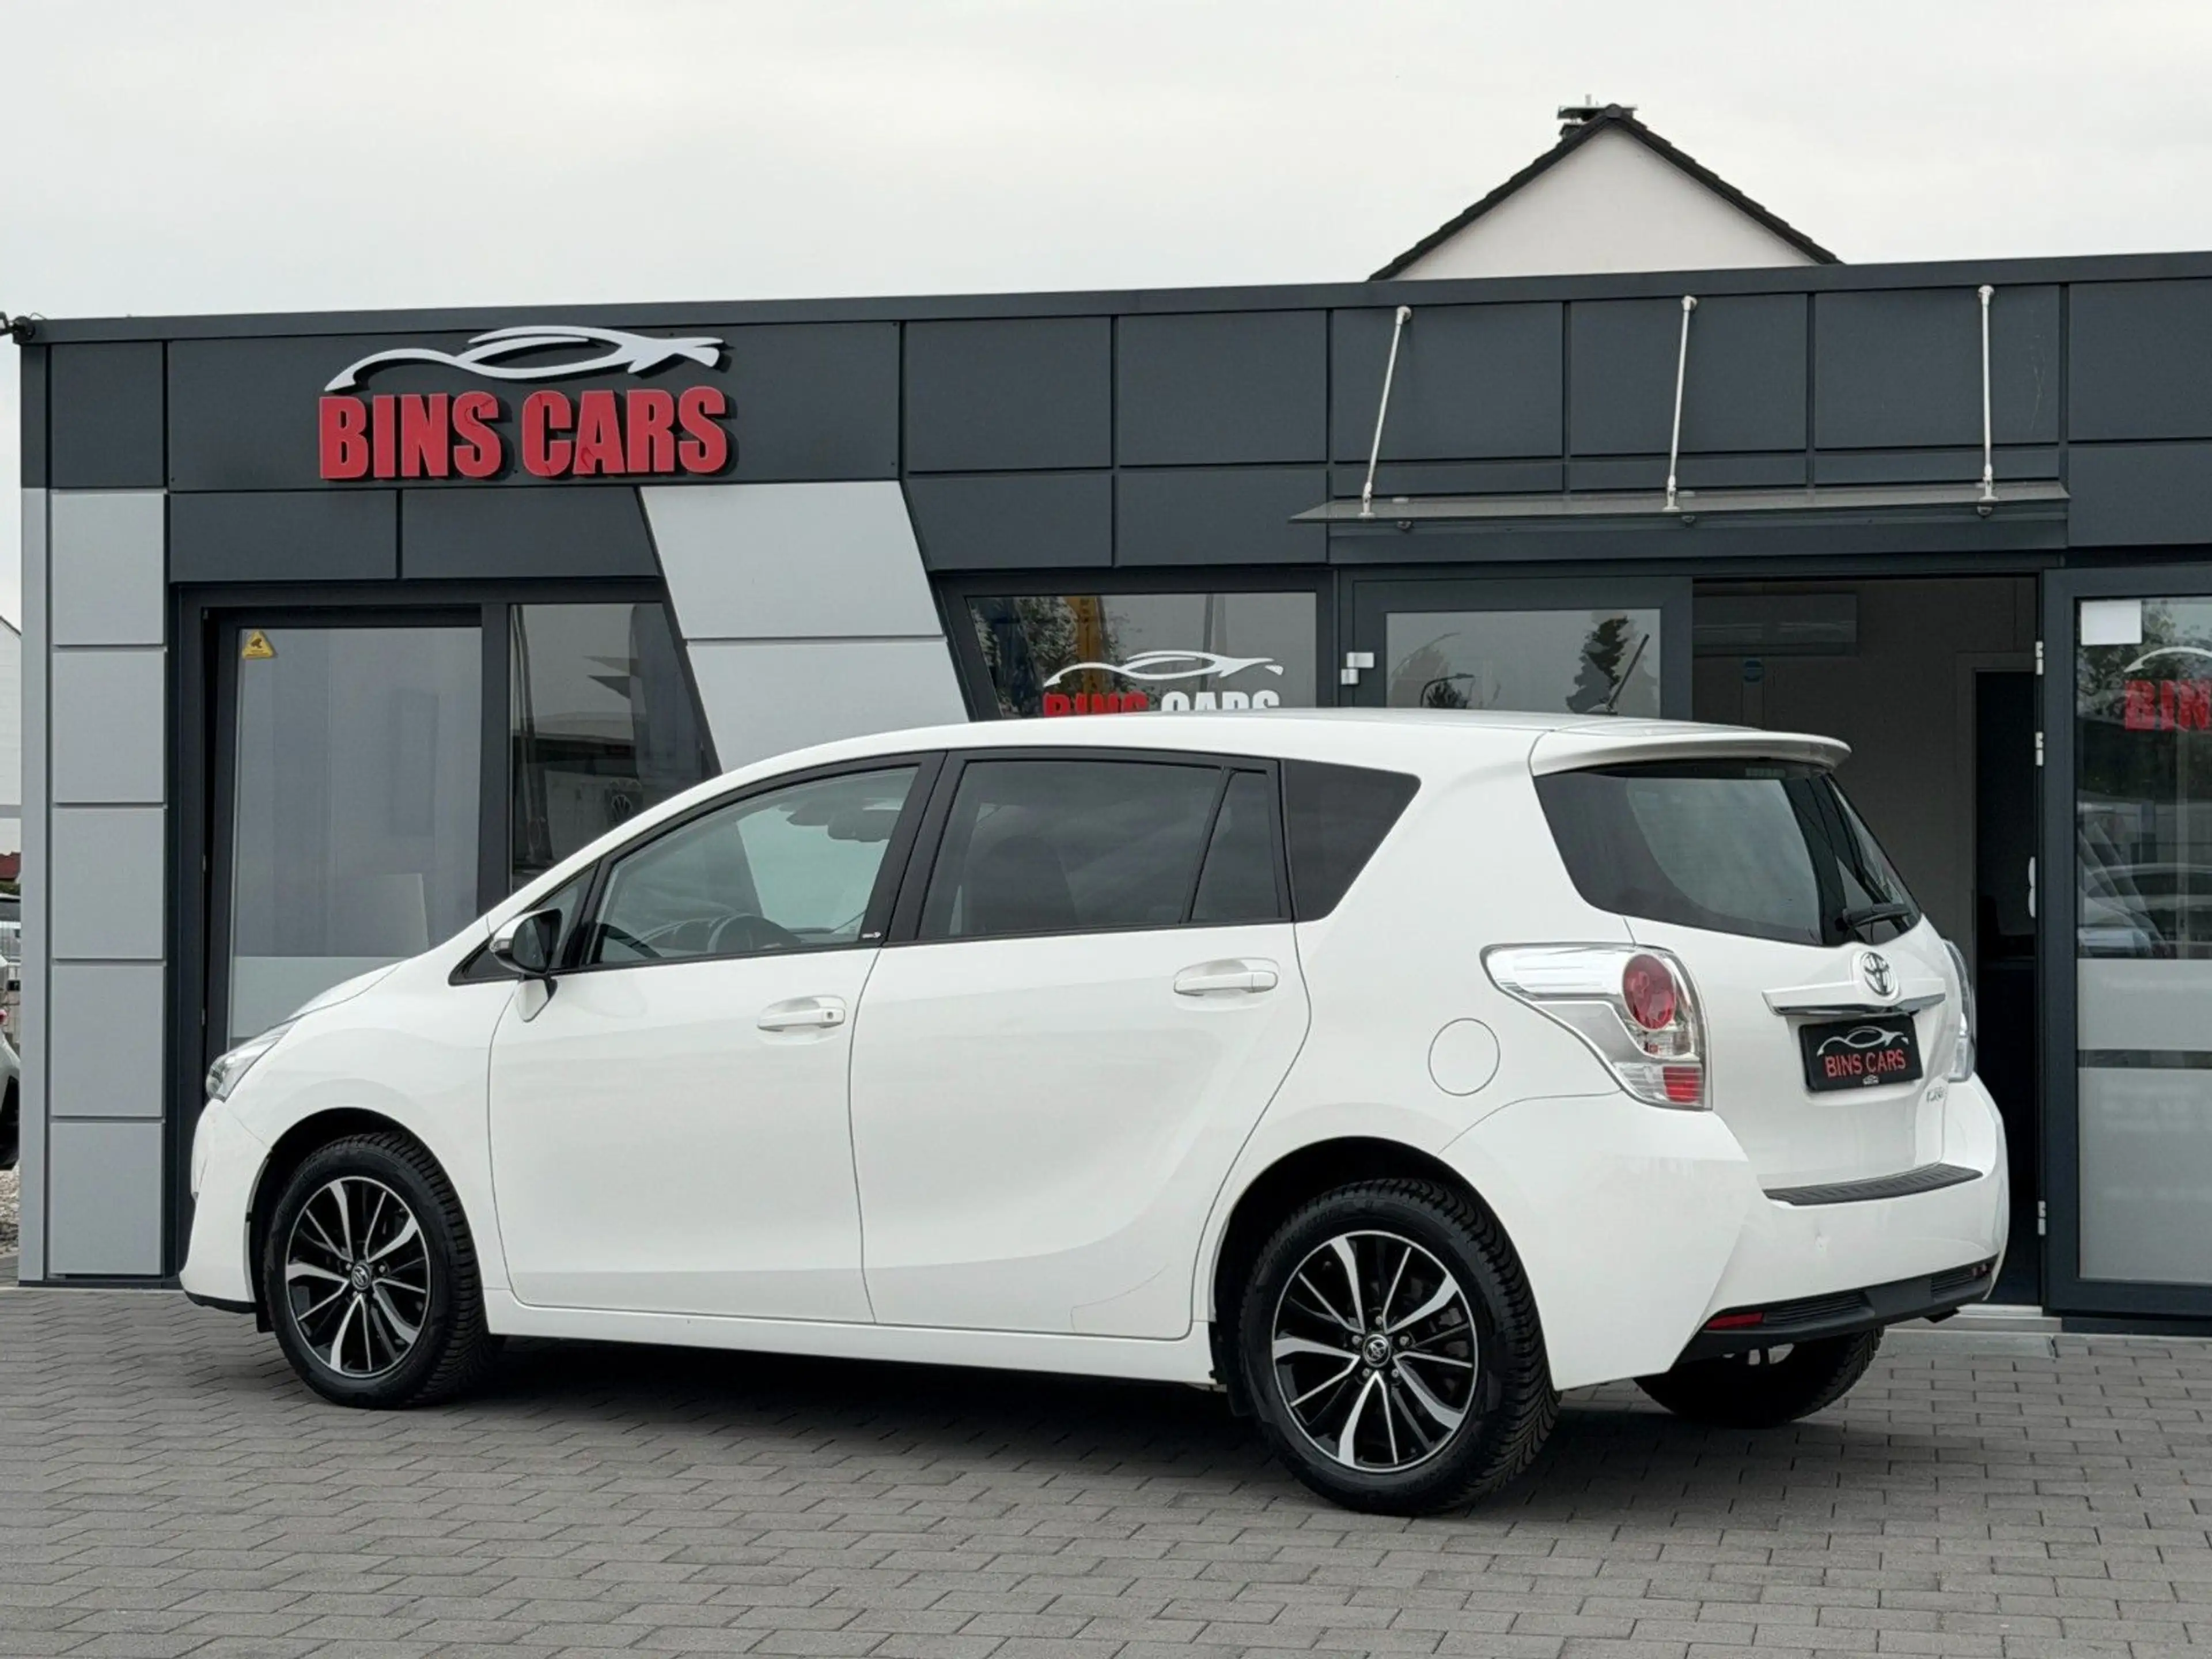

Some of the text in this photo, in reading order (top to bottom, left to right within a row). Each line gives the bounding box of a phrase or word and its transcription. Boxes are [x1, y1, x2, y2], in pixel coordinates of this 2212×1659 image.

[319, 385, 728, 479] BINS CARS
[1825, 1049, 1906, 1078] BINS CARS
